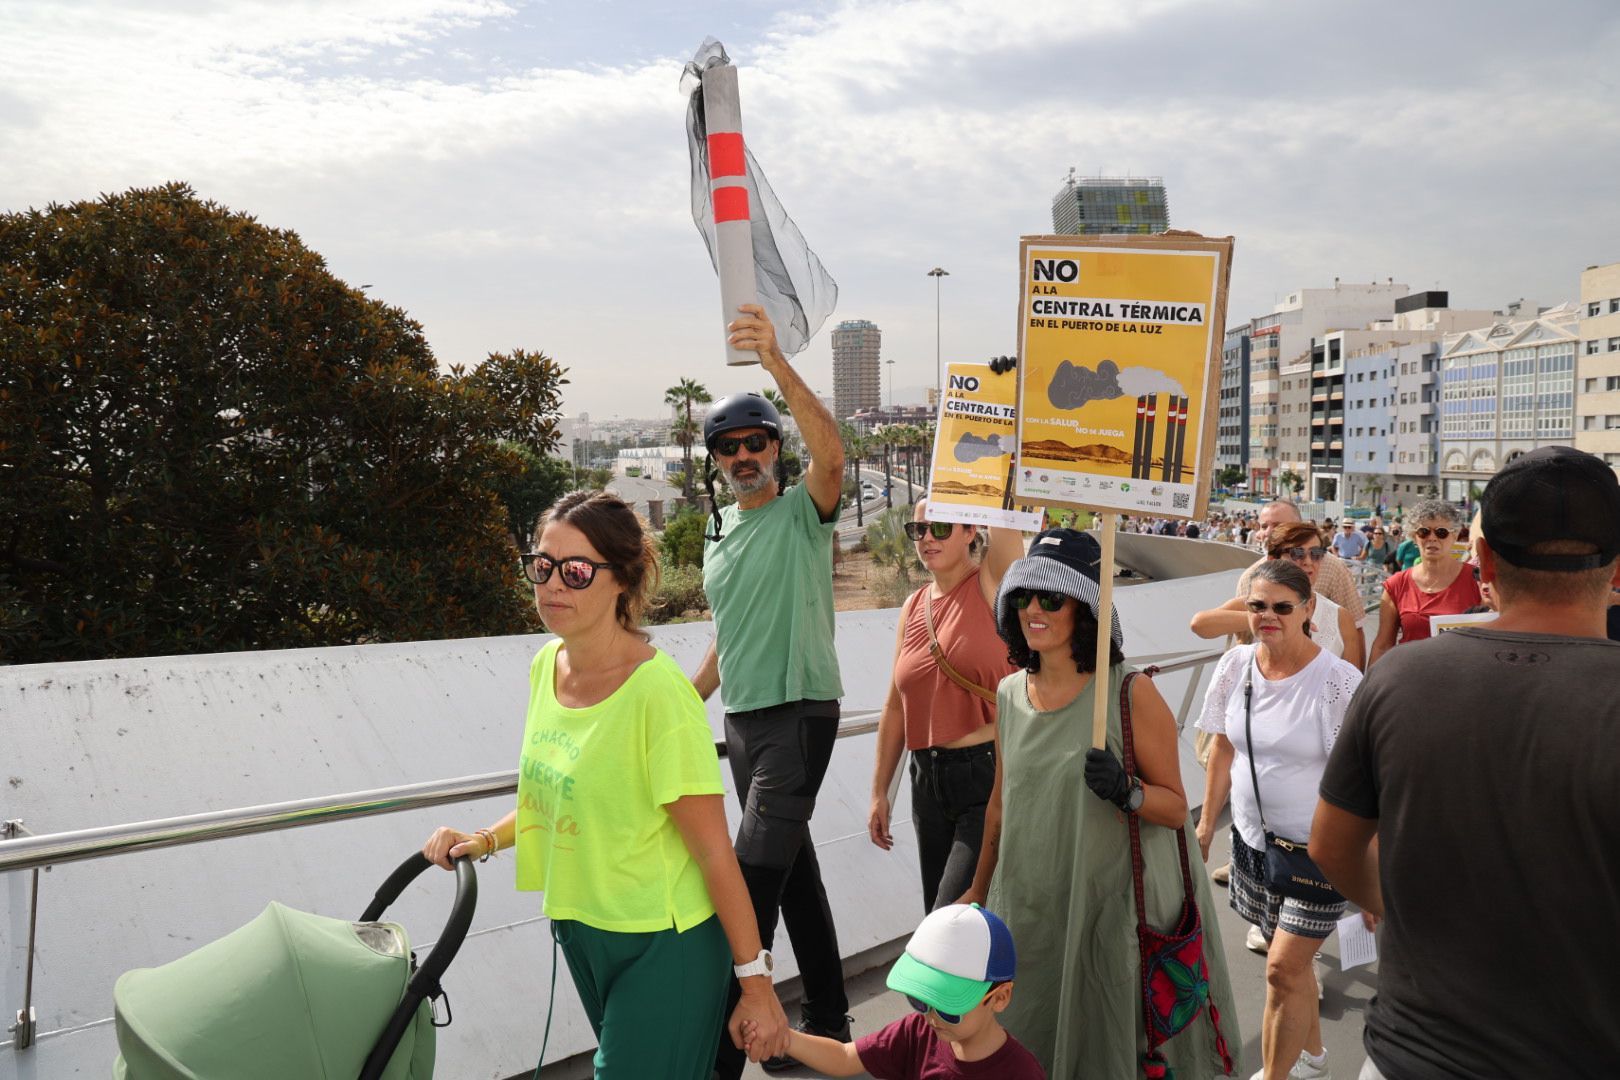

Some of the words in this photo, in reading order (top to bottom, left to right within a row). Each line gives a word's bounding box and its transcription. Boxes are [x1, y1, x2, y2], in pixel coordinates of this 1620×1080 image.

[1033, 259, 1079, 282] NO
[1032, 285, 1041, 294] A
[1043, 286, 1058, 295] LA
[1032, 300, 1114, 318] CENTRAL
[1120, 302, 1203, 322] TÉRMICA
[1030, 319, 1045, 328] EN
[1048, 320, 1059, 329] EL
[1062, 320, 1104, 332] PUERTO
[1106, 323, 1120, 332] DE
[1122, 324, 1137, 333] LA
[1140, 324, 1163, 335] LUZ
[949, 375, 979, 391] NO
[946, 400, 999, 416] CENTRAL
[965, 414, 992, 424] PUERTO
[1004, 418, 1014, 426] LA
[1050, 417, 1080, 428] SALUD
[1075, 426, 1088, 434] NO
[1098, 428, 1125, 437] JUEGA
[531, 729, 580, 761] CHACHO
